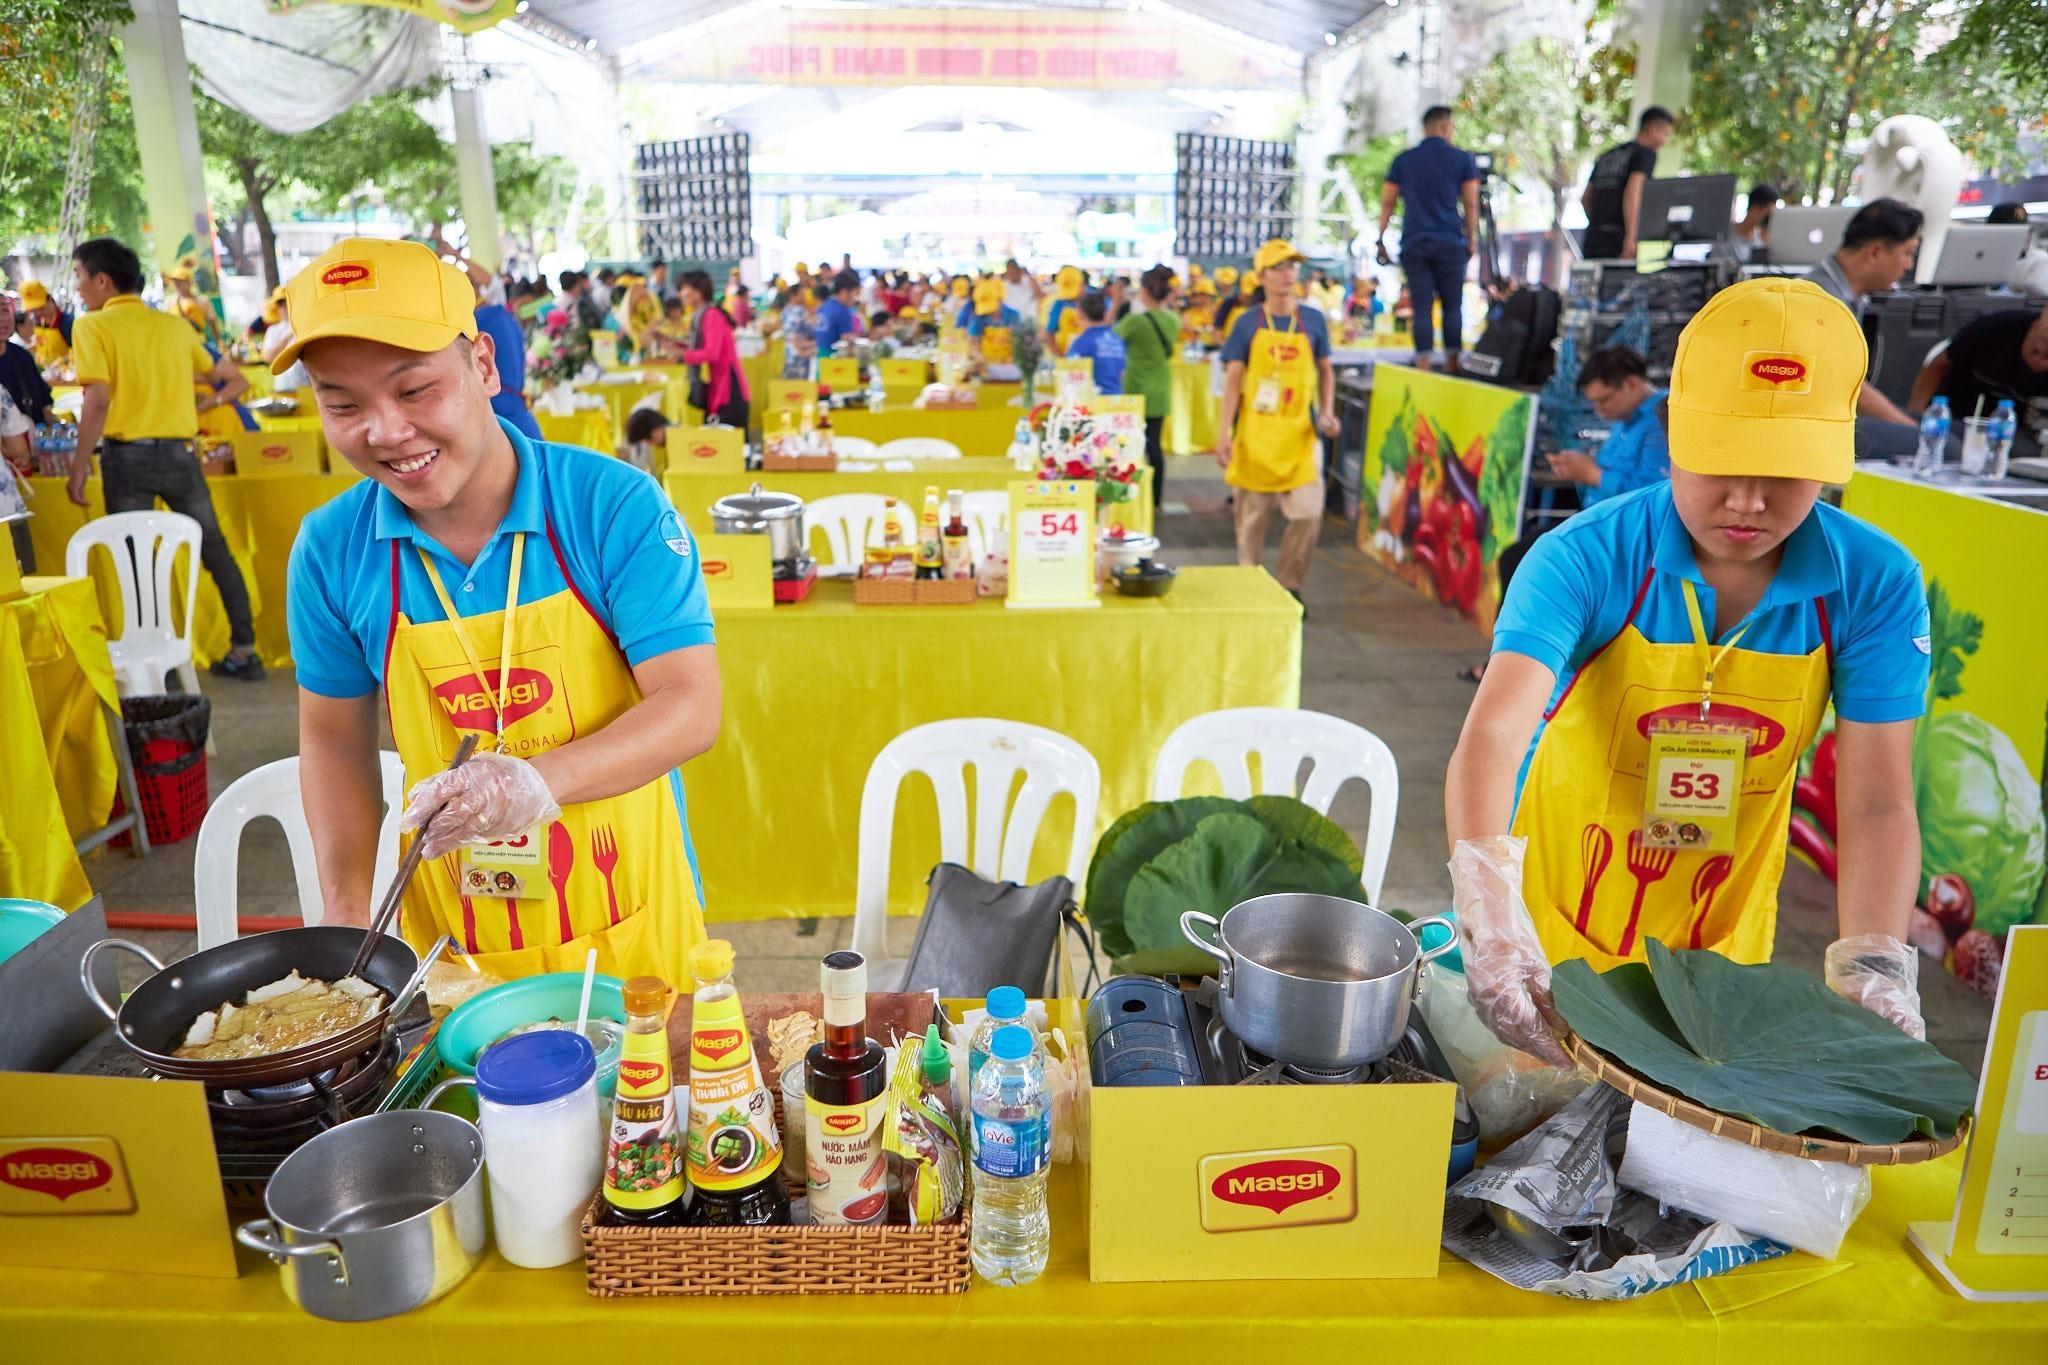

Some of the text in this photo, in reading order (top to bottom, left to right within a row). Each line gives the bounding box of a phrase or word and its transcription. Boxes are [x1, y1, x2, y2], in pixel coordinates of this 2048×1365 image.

[327, 269, 363, 281] Maggi
[1758, 365, 1799, 376] Maggi
[1041, 513, 1078, 536] 54
[1669, 772, 1720, 800] 53
[694, 1033, 739, 1050] Maggi
[620, 1064, 659, 1080] Maggi
[7, 1160, 99, 1181] Maggi
[2015, 1167, 2021, 1177] 1
[1228, 1170, 1324, 1195] Maggi
[2009, 1187, 2018, 1197] 2
[2004, 1207, 2014, 1218] 3
[2000, 1228, 2009, 1238] 4
